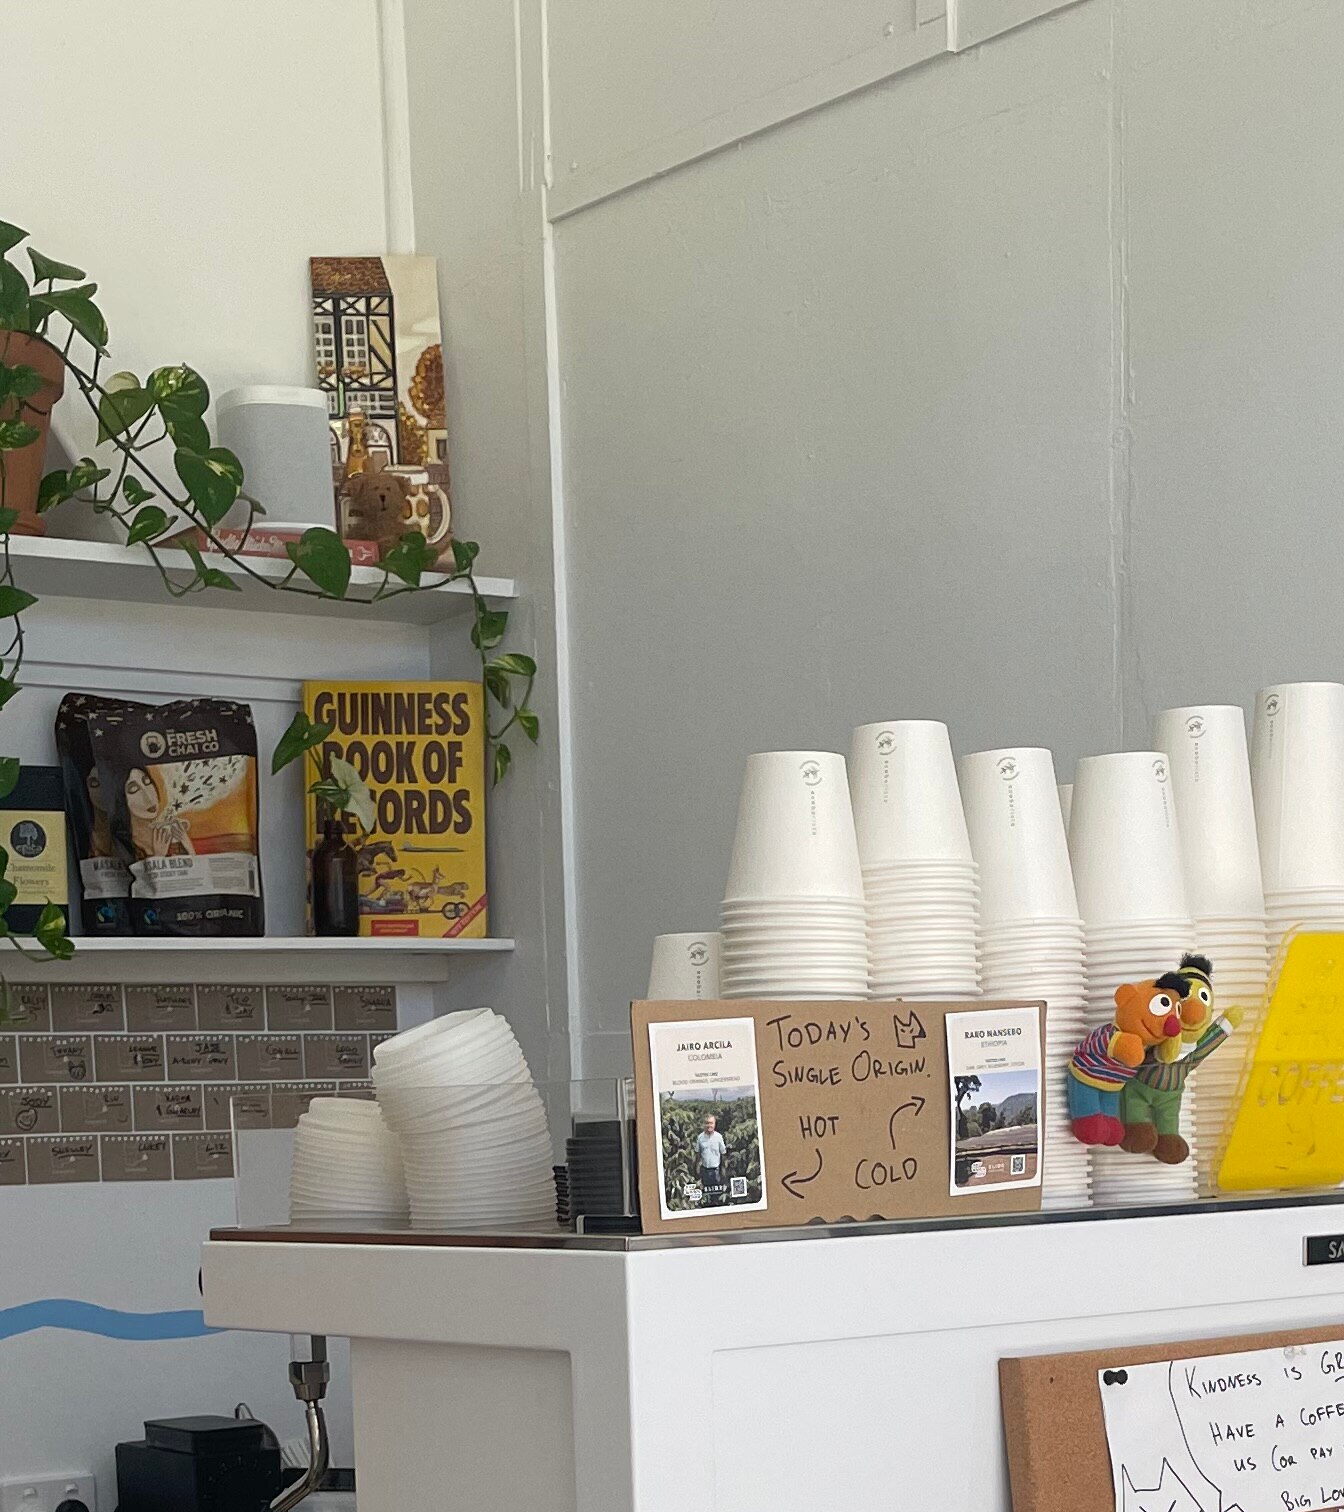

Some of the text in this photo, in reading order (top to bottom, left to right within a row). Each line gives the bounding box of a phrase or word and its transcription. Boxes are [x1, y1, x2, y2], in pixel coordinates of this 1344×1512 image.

[314, 692, 471, 736] GUINNESS
[167, 729, 218, 746] FRESH
[168, 741, 220, 757] CHAI CO
[424, 741, 463, 784] OF
[169, 857, 194, 870] BLEND
[677, 1040, 733, 1052] JAIRO ARCILA
[767, 1014, 871, 1052] TODAY'S
[773, 1060, 843, 1088] SINGLE
[851, 1050, 932, 1083] ORIGIN.
[799, 1115, 840, 1139] HOT
[856, 1157, 918, 1190] COLD
[1184, 1365, 1263, 1400] KINDNESS
[1284, 1365, 1303, 1381] IS
[1210, 1421, 1256, 1446] HAVE
[1274, 1413, 1285, 1428] A
[1234, 1457, 1257, 1473] US
[1272, 1446, 1298, 1473] (OR
[1309, 1446, 1334, 1461] PAY
[1280, 1491, 1313, 1512] BIG
